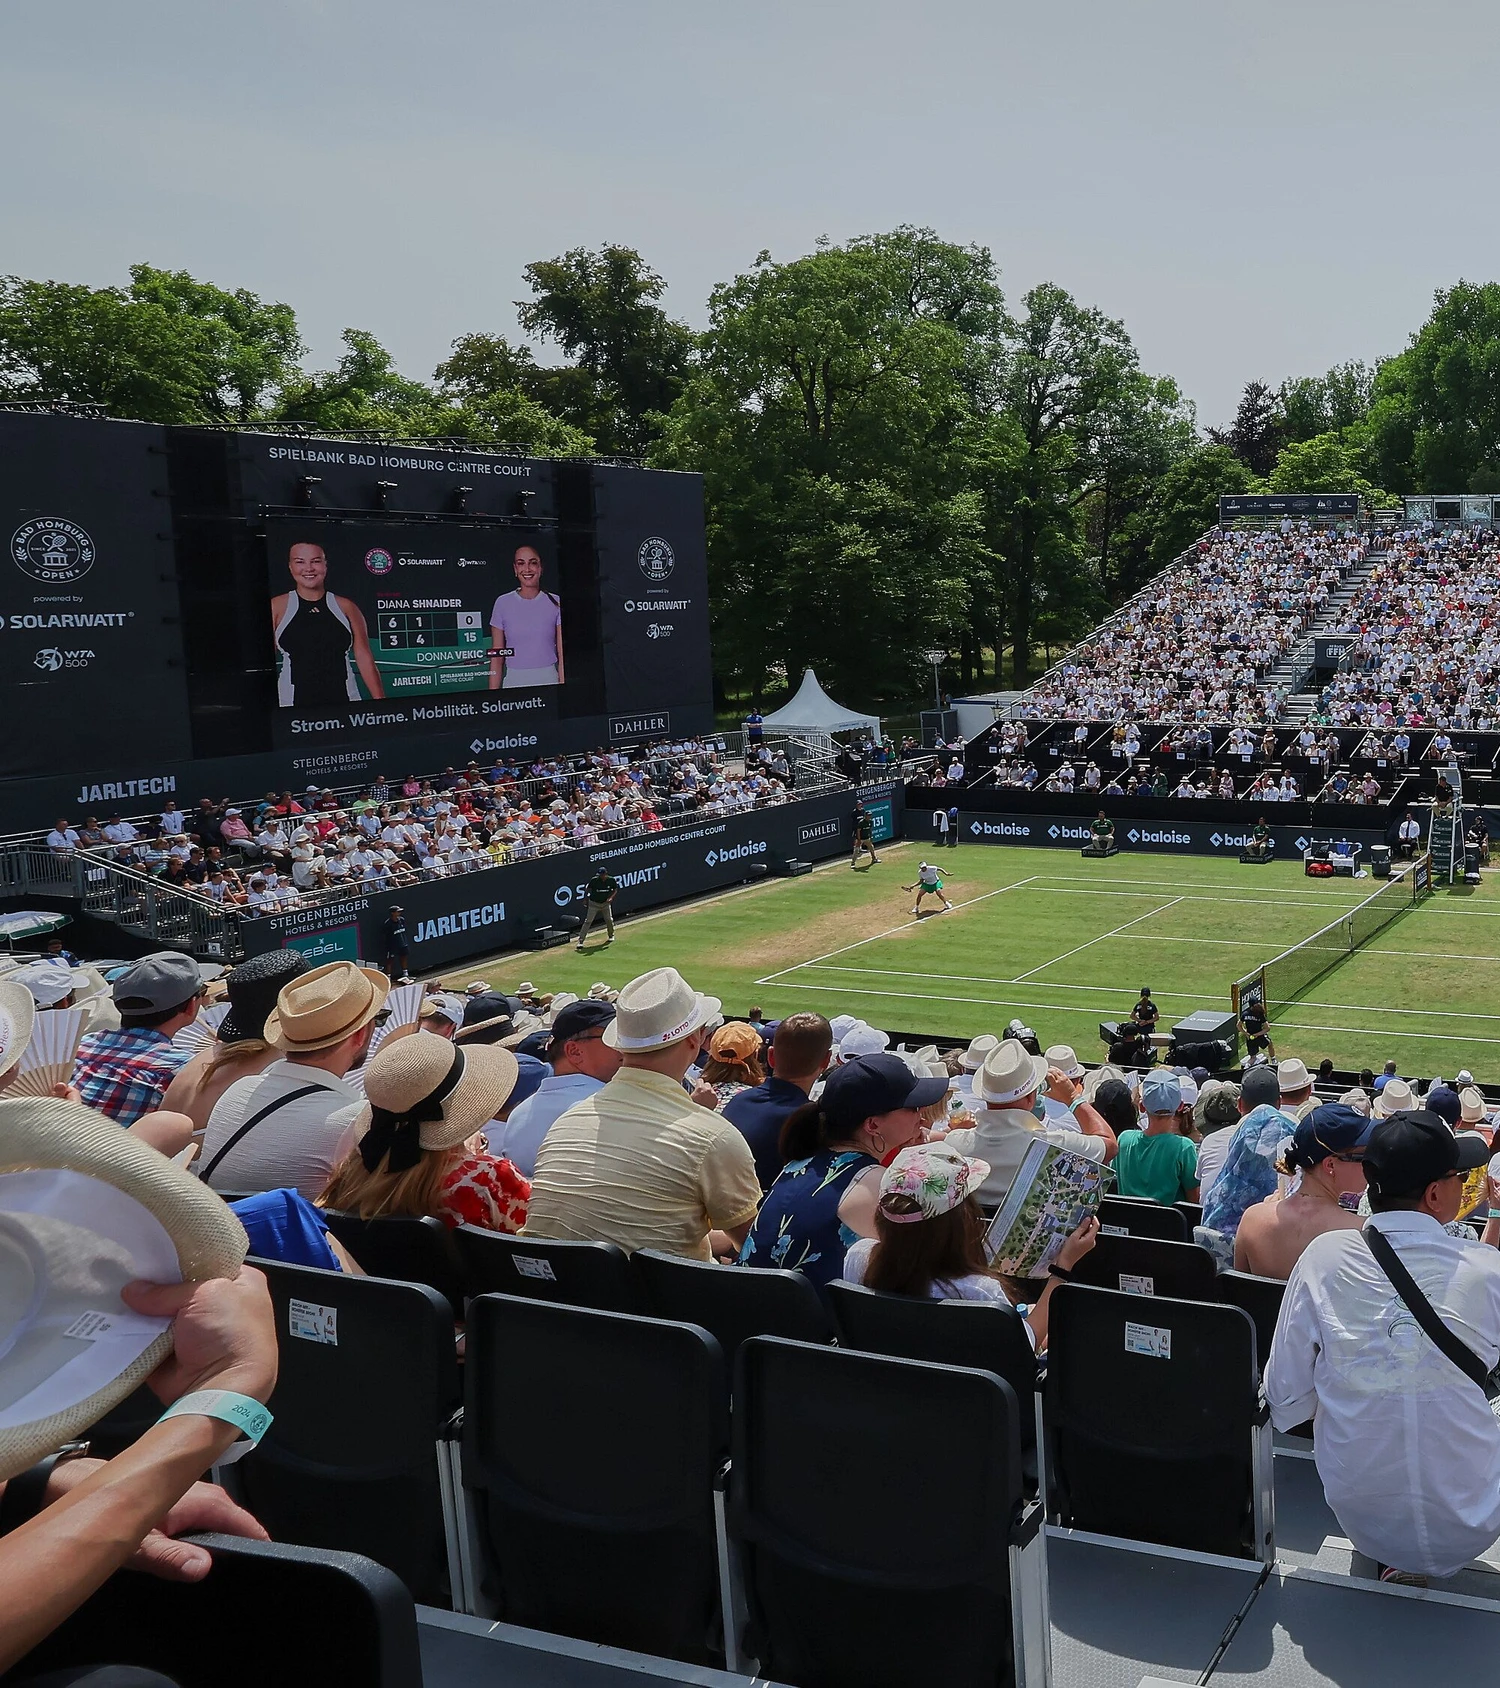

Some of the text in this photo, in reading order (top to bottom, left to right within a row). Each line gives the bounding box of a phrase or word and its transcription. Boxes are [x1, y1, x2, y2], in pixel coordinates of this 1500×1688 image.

[269, 448, 532, 478] SPIELBANK BAD HOMBURG CENTRE COURT
[16, 520, 90, 547] BAD HOMBURG
[42, 570, 74, 580] OPEN
[34, 595, 84, 604] powered by
[378, 599, 462, 609] DIANA SHNAIDER
[388, 616, 474, 628] 6 1 0
[390, 632, 476, 646] 3 4 15
[64, 650, 96, 658] WTA
[417, 650, 484, 662] DONNA VEKIC
[65, 658, 88, 668] 500
[392, 676, 432, 686] JARLTECH
[291, 696, 546, 734] Strom. Wärme. Mobilität. Solarwatt.
[614, 718, 665, 734] DAHLER
[486, 733, 538, 751] baloise
[293, 750, 378, 770] STEIGENBERGER
[306, 768, 332, 776] HOTELS
[340, 762, 368, 772] RESORTS
[77, 775, 176, 804] JARLTECH
[856, 782, 897, 797] STEIGENBERGER
[872, 816, 884, 827] 131
[983, 822, 1030, 836] baloise
[802, 823, 837, 840] DAHLER
[1061, 826, 1092, 839] balo
[1141, 829, 1191, 844] baloise
[590, 824, 726, 862] SPIELBANK BAD HOMBURG CENTRE COURT
[719, 840, 767, 863] baloise
[270, 900, 369, 930] STEIGENBERGER
[413, 902, 506, 943] JARLTECH
[285, 924, 315, 936] HOTELS
[325, 914, 357, 926] RESORTS
[302, 942, 344, 959] EBEL
[671, 1021, 689, 1036] LOTTO
[1020, 1080, 1031, 1092] LOTTO
[232, 1405, 250, 1418] 2024
